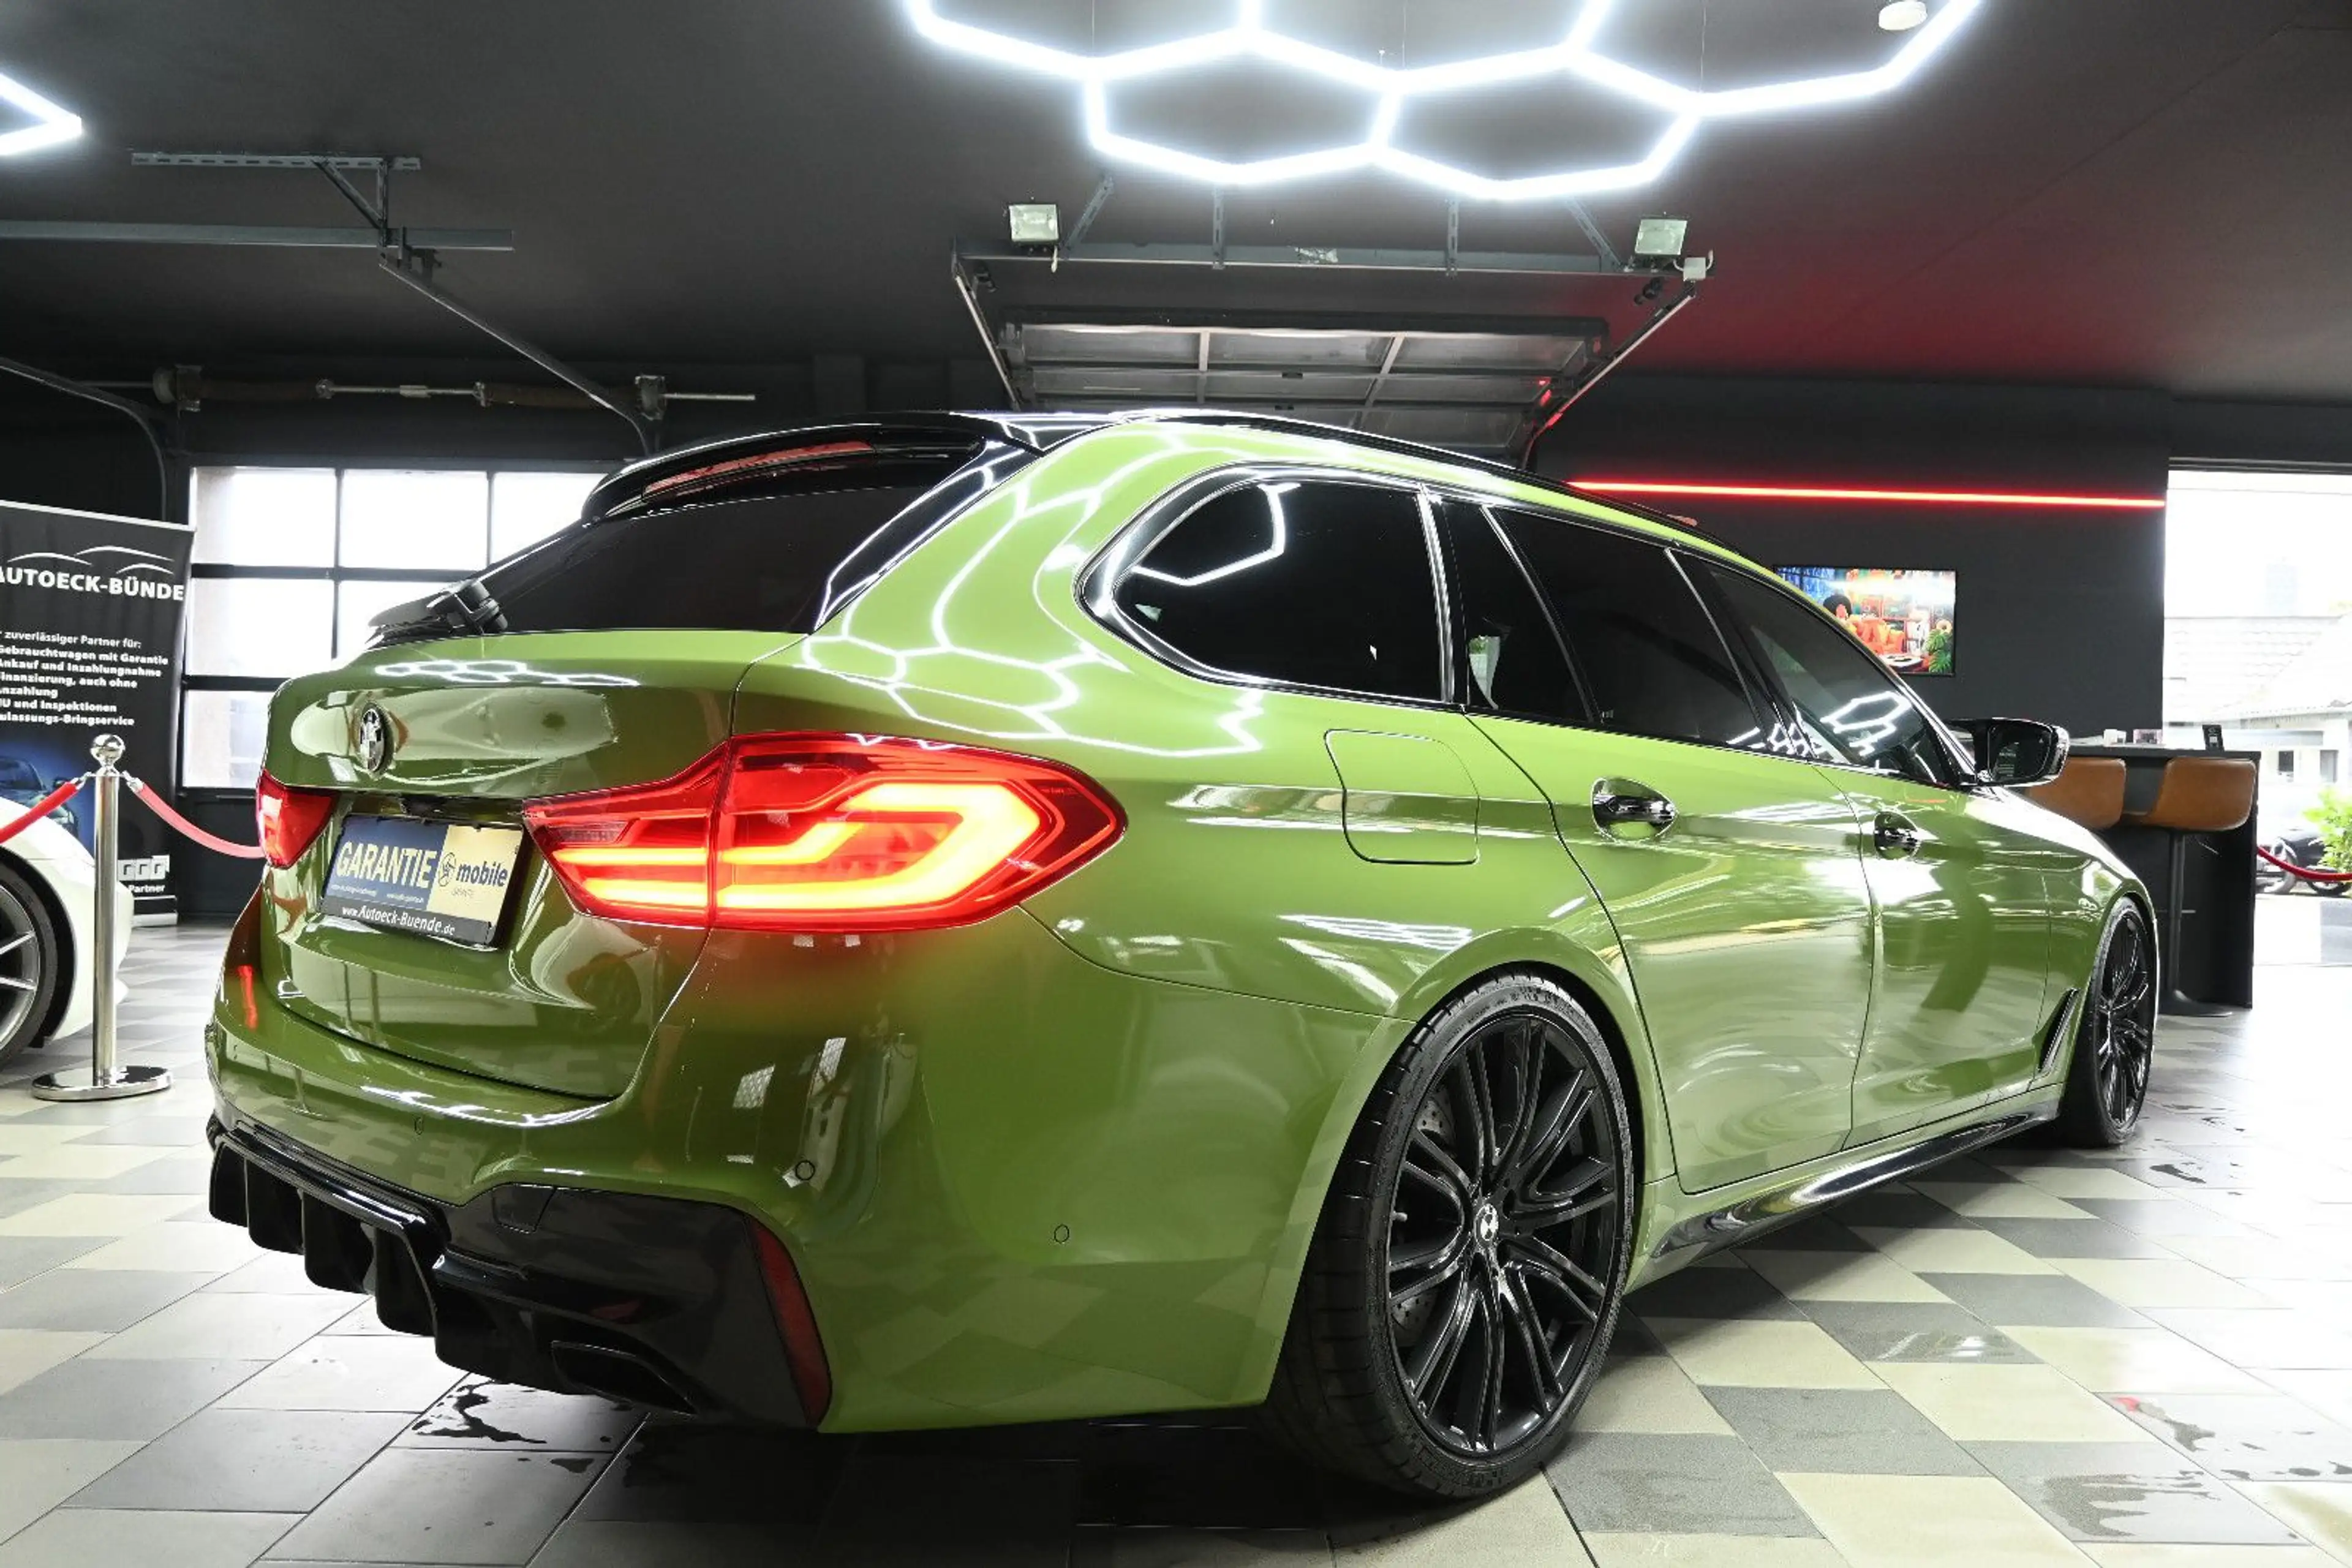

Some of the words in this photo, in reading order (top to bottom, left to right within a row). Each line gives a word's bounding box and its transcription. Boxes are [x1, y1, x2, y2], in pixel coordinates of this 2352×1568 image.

[4, 631, 78, 646] zuverlässiger
[81, 635, 120, 647] Partner
[123, 638, 141, 649] für:
[99, 652, 118, 662] mit
[120, 653, 169, 665] Garantie
[41, 661, 64, 671] und
[67, 663, 162, 677] Inzahlungnahme
[0, 671, 76, 687] inanzierung,
[79, 677, 107, 687] auch
[108, 677, 138, 688] ohne
[0, 685, 59, 699] nzahlung
[13, 699, 37, 709] und
[40, 700, 117, 712] Inspektionen
[0, 711, 135, 727] ulassungs-Bringservice
[337, 841, 437, 888] GARANTIE
[456, 861, 508, 887] mobile
[128, 884, 166, 893] Partner
[342, 905, 455, 936] www.Autoeck-Buende.de
